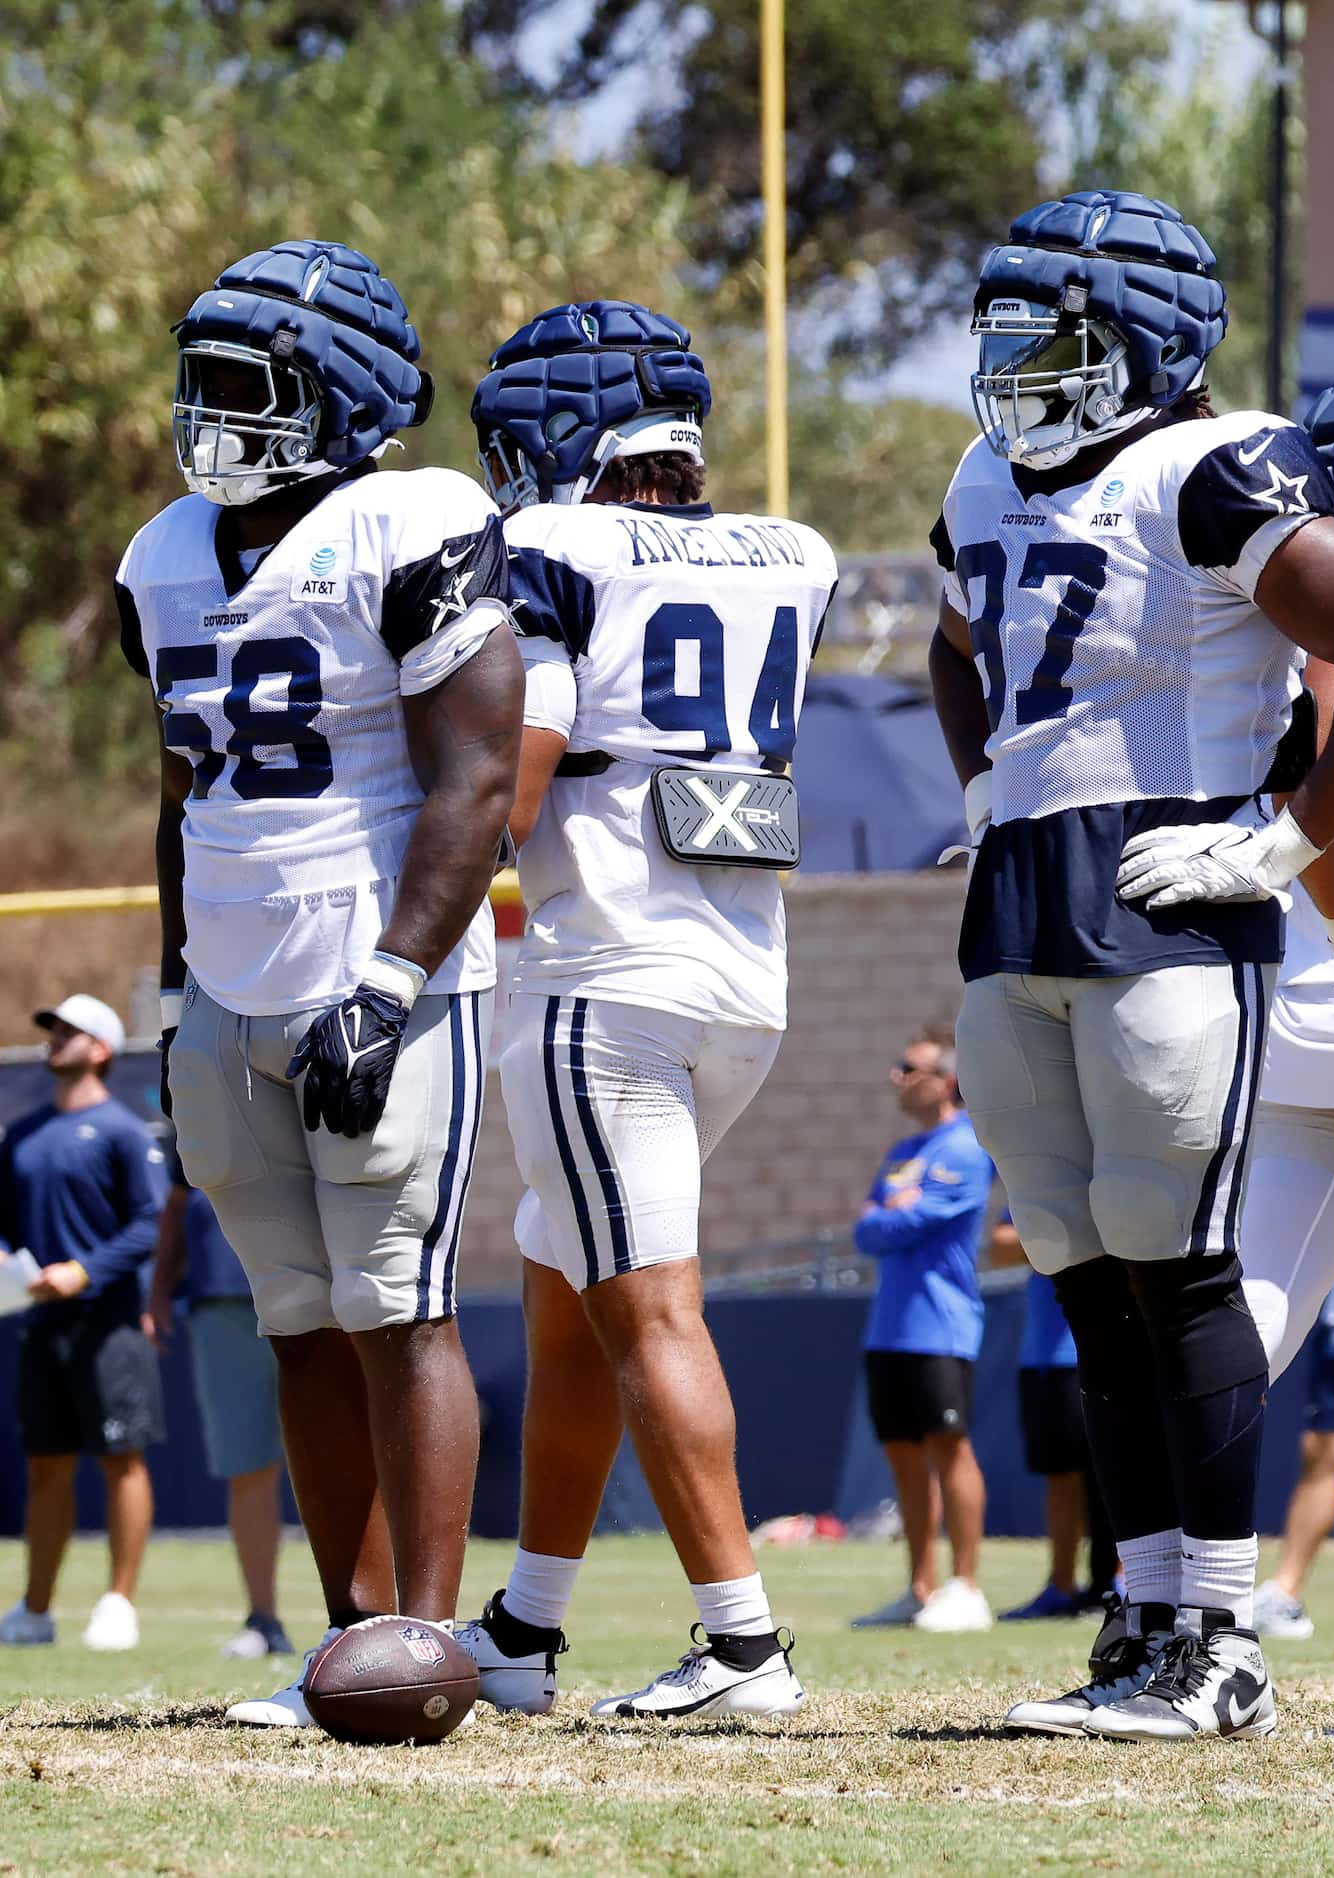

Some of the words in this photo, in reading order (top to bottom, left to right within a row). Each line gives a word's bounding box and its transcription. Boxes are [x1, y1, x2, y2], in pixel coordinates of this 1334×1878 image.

[1001, 513, 1047, 527] COWBOYS
[1090, 513, 1123, 528] AT&T
[616, 519, 805, 567] KNEELAND
[302, 580, 336, 595] AT&T
[203, 612, 249, 628] COWBOYS
[641, 603, 798, 764] 94
[156, 636, 335, 800] 58
[414, 1640, 442, 1660] NFL
